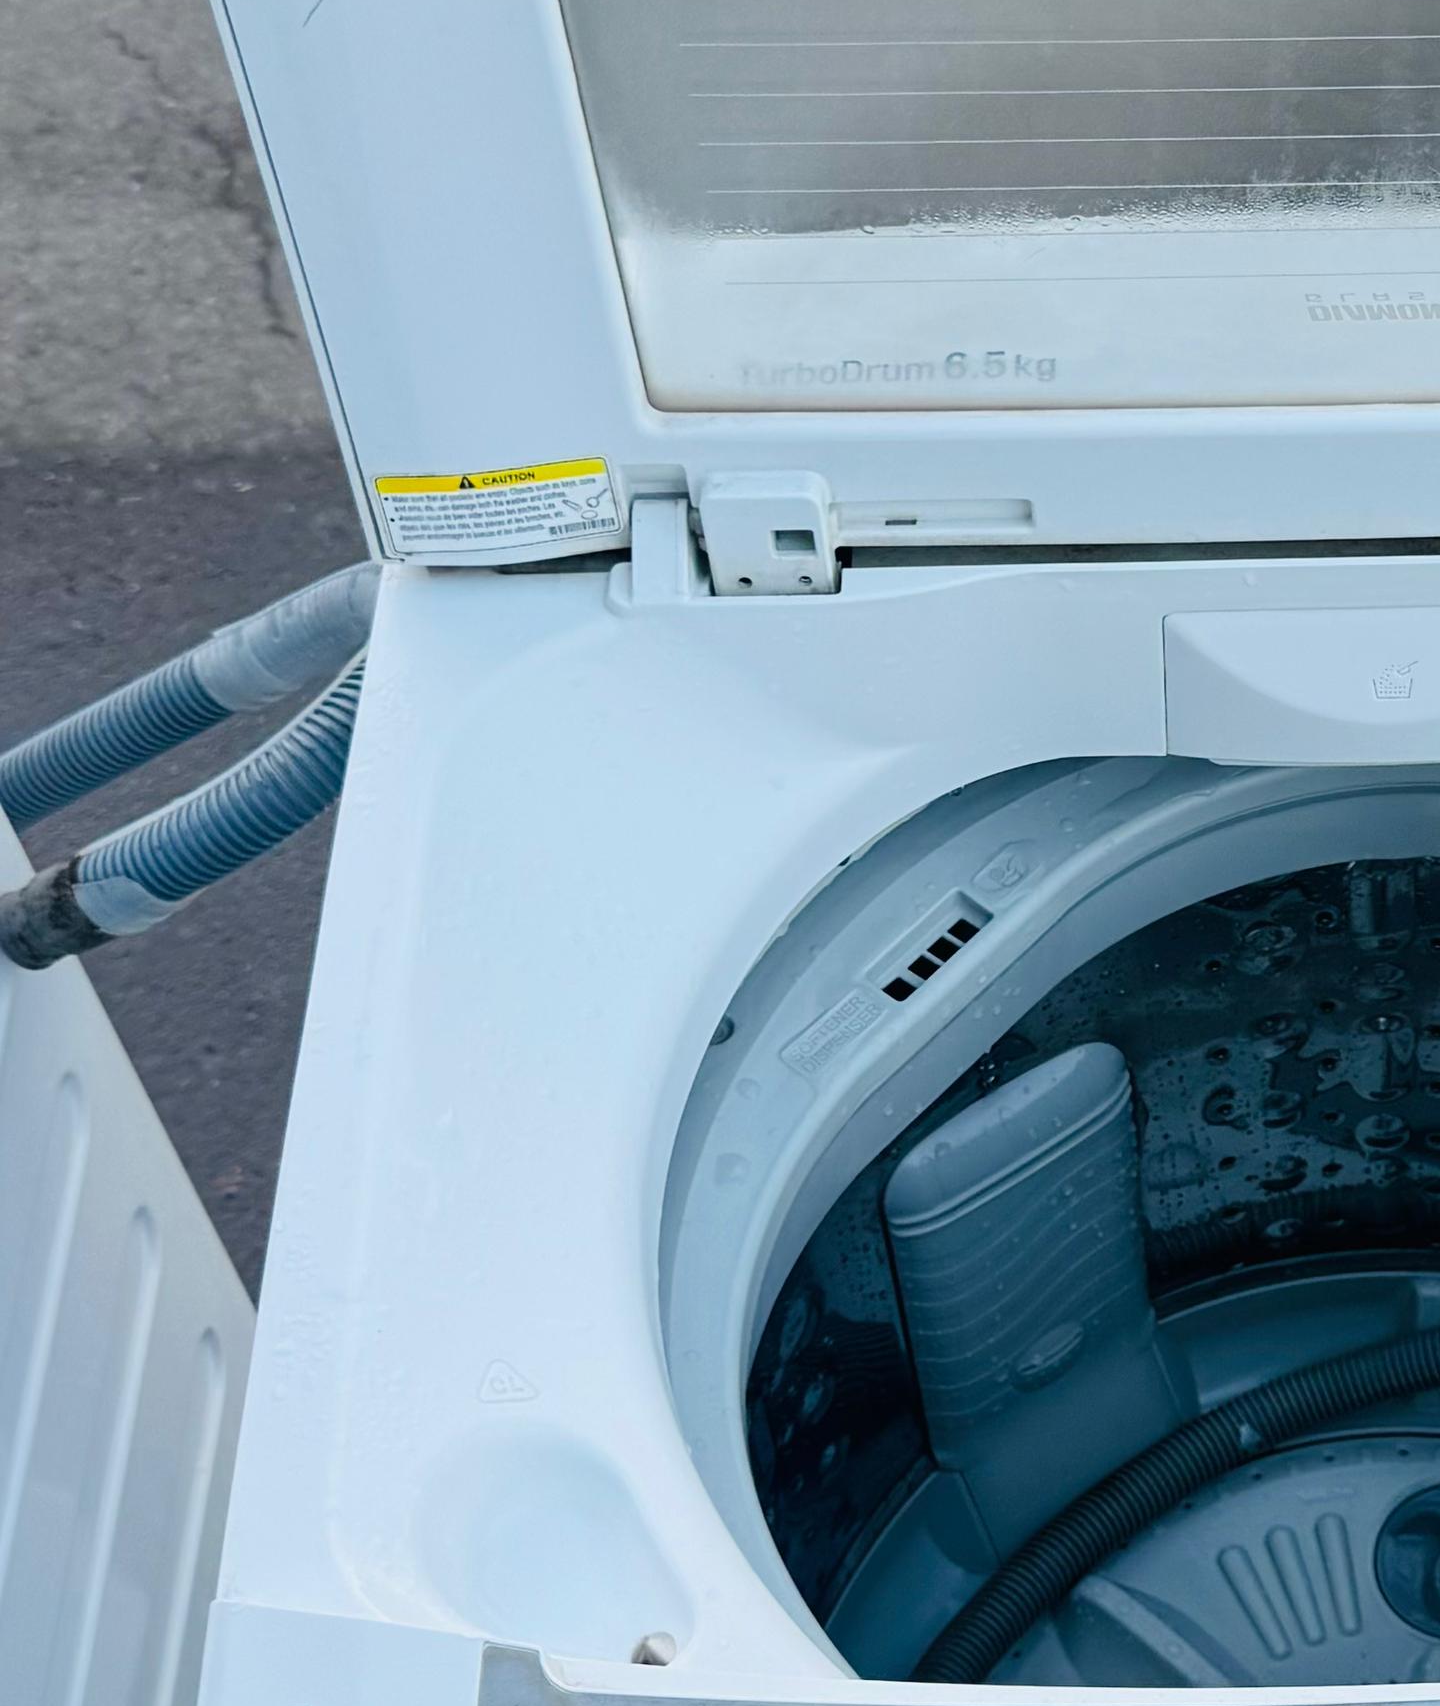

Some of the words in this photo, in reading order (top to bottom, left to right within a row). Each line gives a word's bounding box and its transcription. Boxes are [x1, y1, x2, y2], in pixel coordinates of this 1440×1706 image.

[482, 472, 535, 486] CAUTION
[790, 995, 866, 1062] SOFTENER
[800, 1003, 884, 1073] DISPENSER
